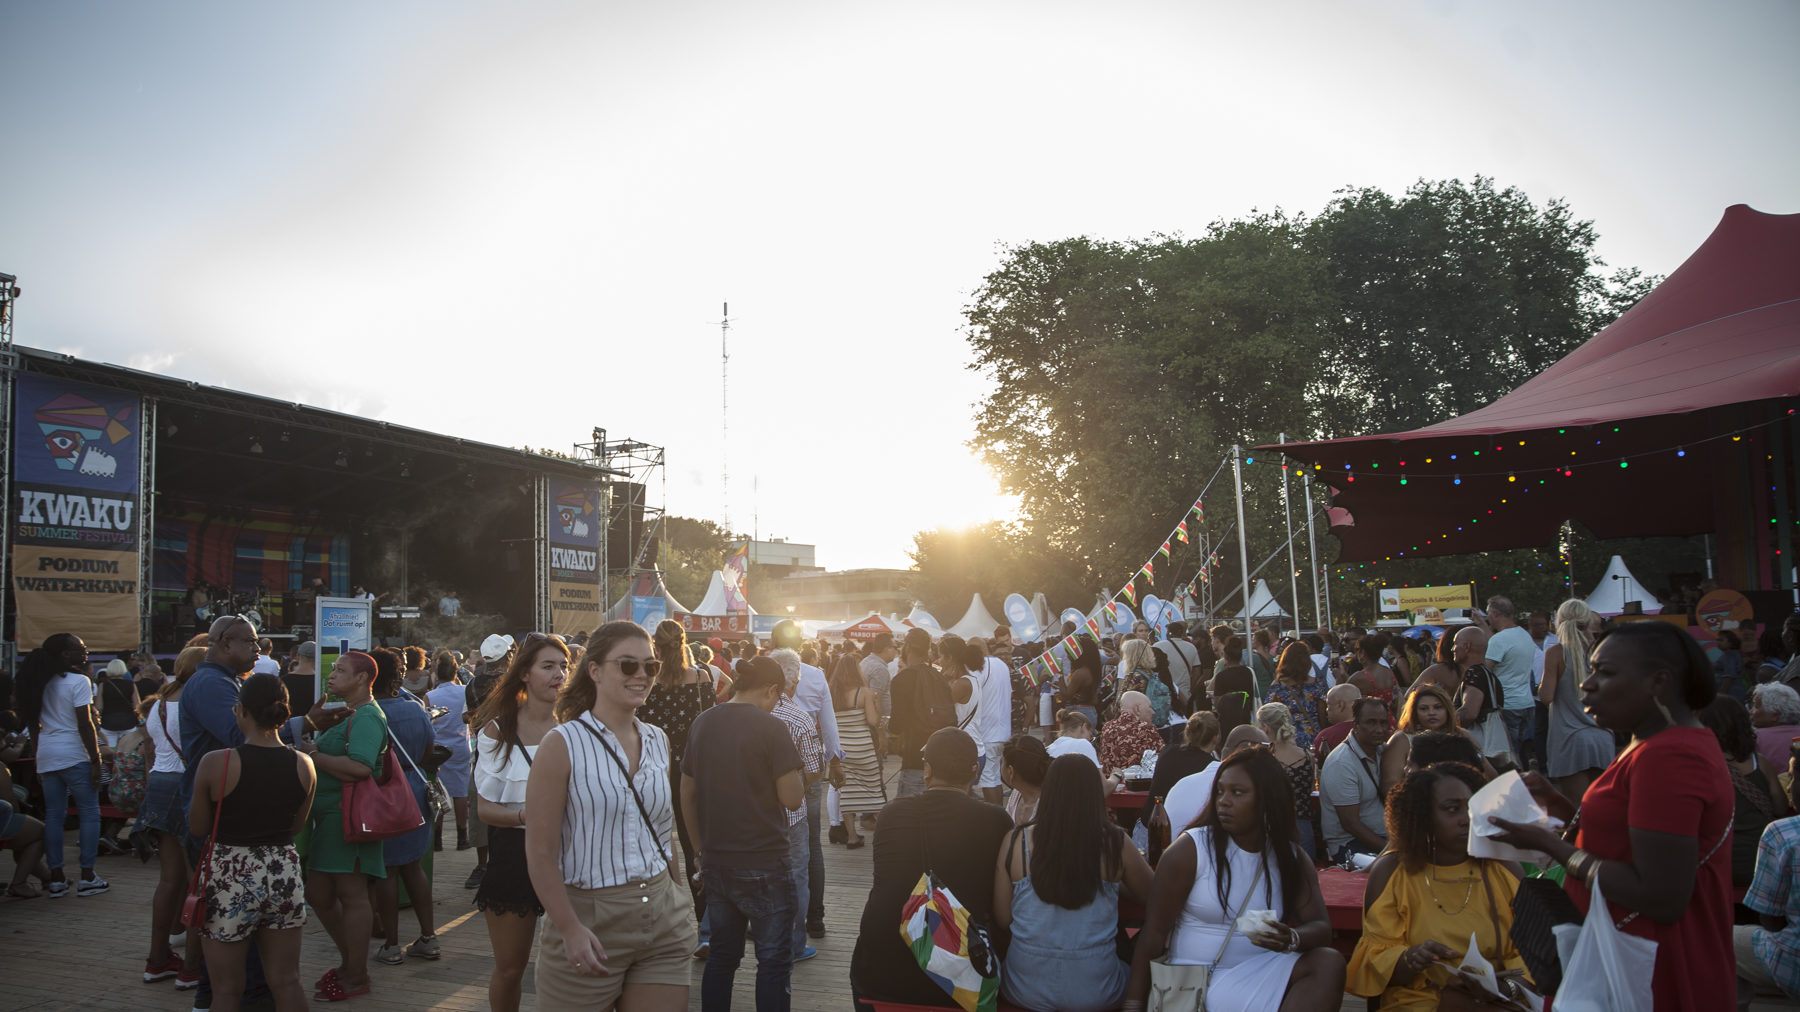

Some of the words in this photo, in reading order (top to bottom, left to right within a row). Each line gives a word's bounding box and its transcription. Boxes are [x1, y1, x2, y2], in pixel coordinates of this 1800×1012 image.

[19, 490, 133, 530] KWAKU
[19, 525, 134, 544] SUMMERFESTIVAL
[38, 557, 119, 574] PODIUM
[551, 547, 597, 571] KWAKU
[15, 576, 136, 594] WATERKANT
[560, 588, 592, 599] PODIUM
[701, 617, 721, 631] BAR
